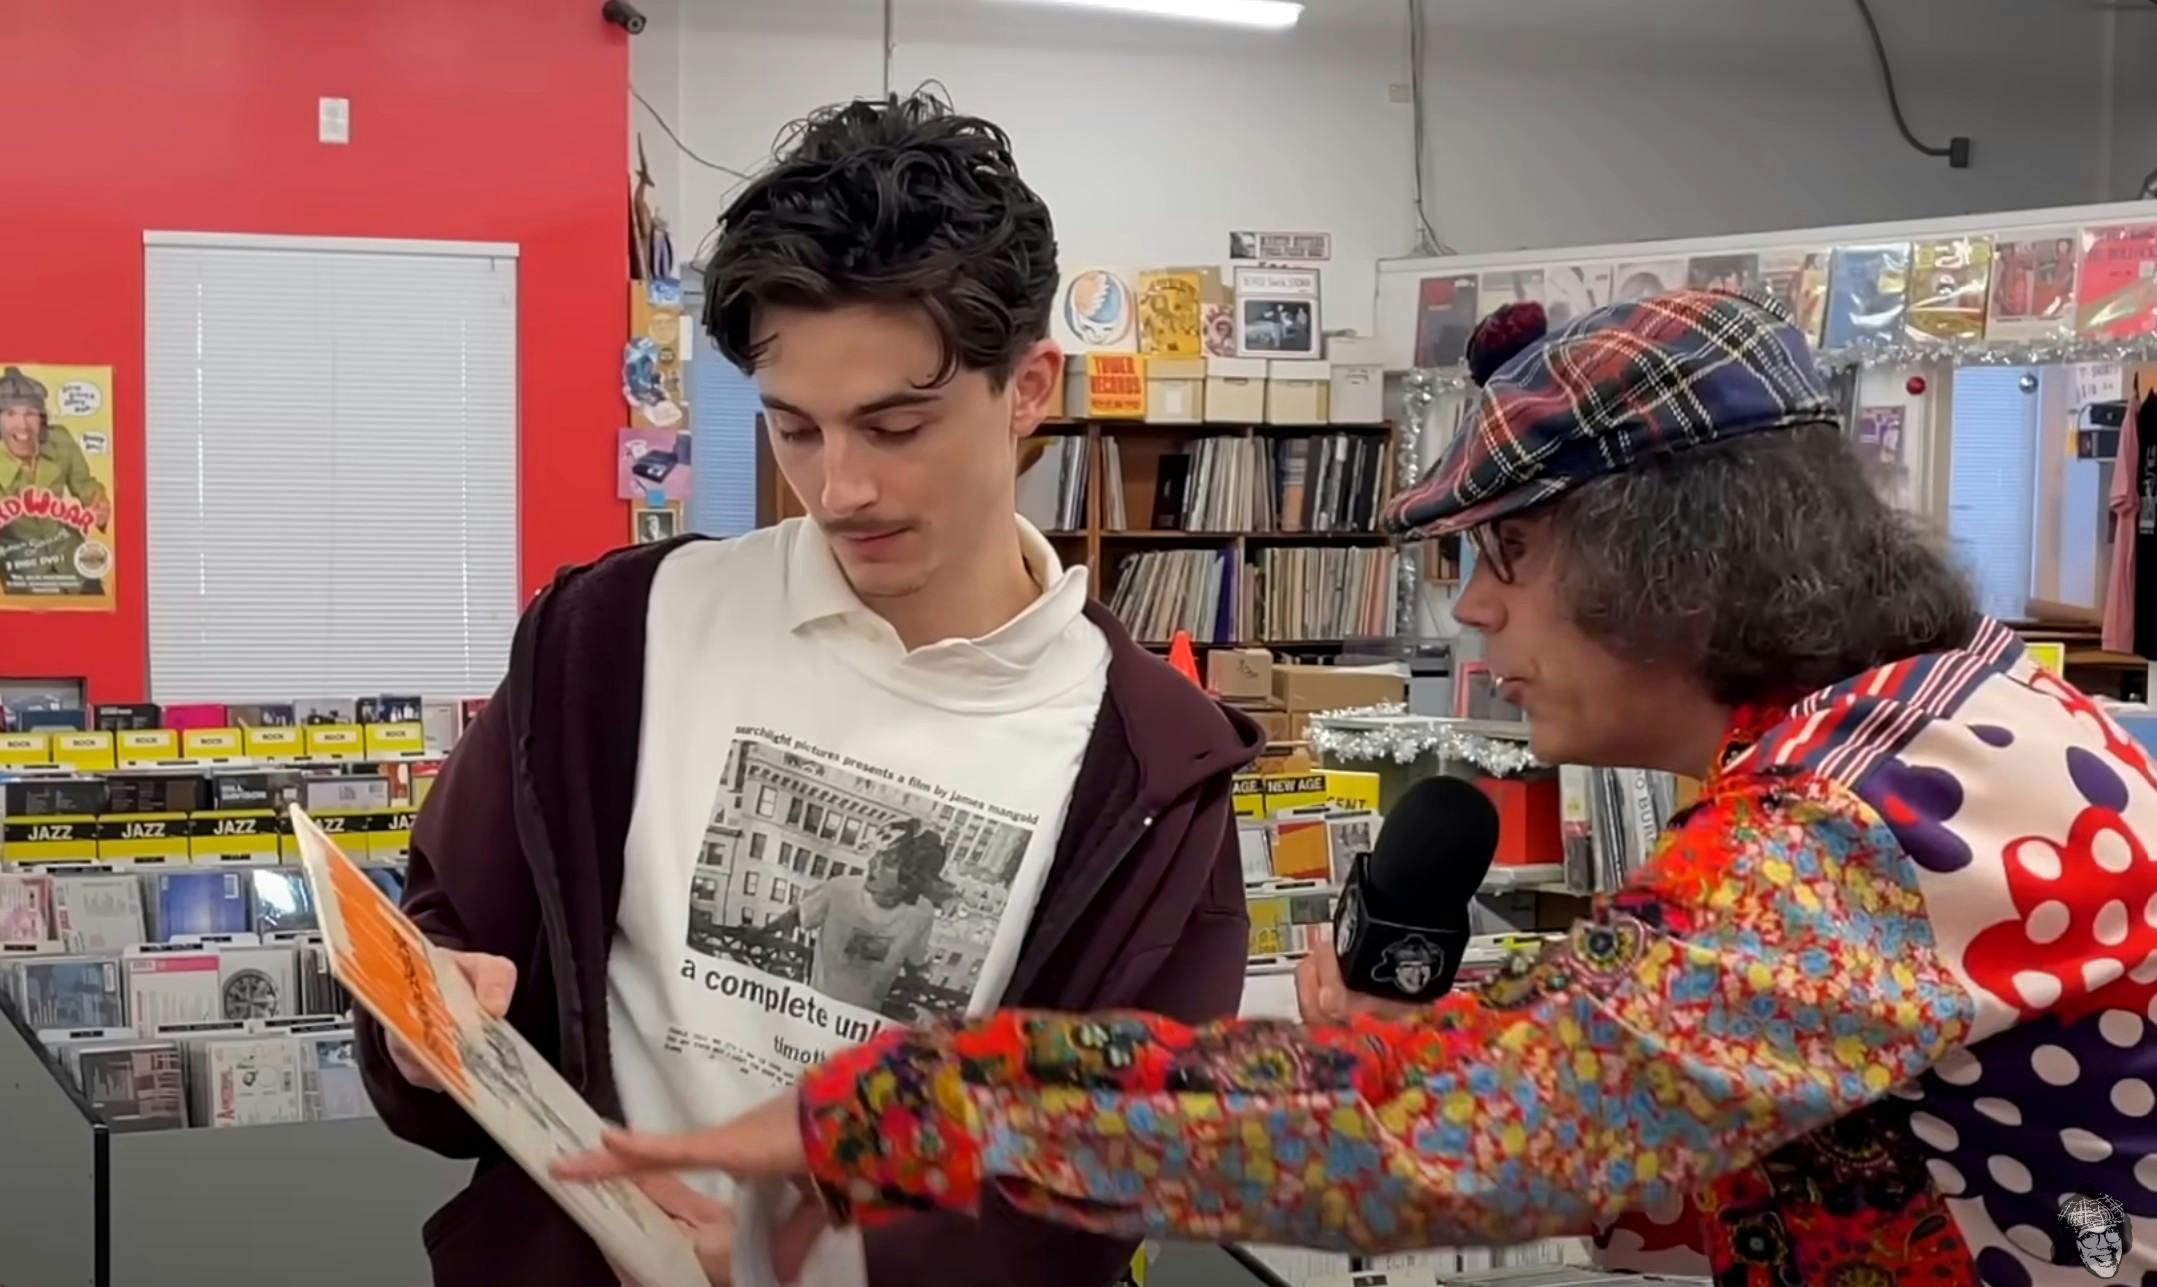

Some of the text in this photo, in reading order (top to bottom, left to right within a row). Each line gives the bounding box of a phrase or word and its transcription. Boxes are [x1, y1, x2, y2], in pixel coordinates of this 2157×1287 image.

[735, 726, 1040, 825] searchlight pictures presents a film by james mangold
[1232, 781, 1258, 793] AGE
[1267, 777, 1322, 792] NEW AGE
[1326, 796, 1368, 809] ENT
[28, 825, 73, 840] JAZZ
[121, 823, 166, 838] JAZZ
[213, 819, 257, 835] JAZZ
[315, 818, 345, 832] AZZ
[680, 958, 696, 980] a
[705, 970, 828, 1028] complete
